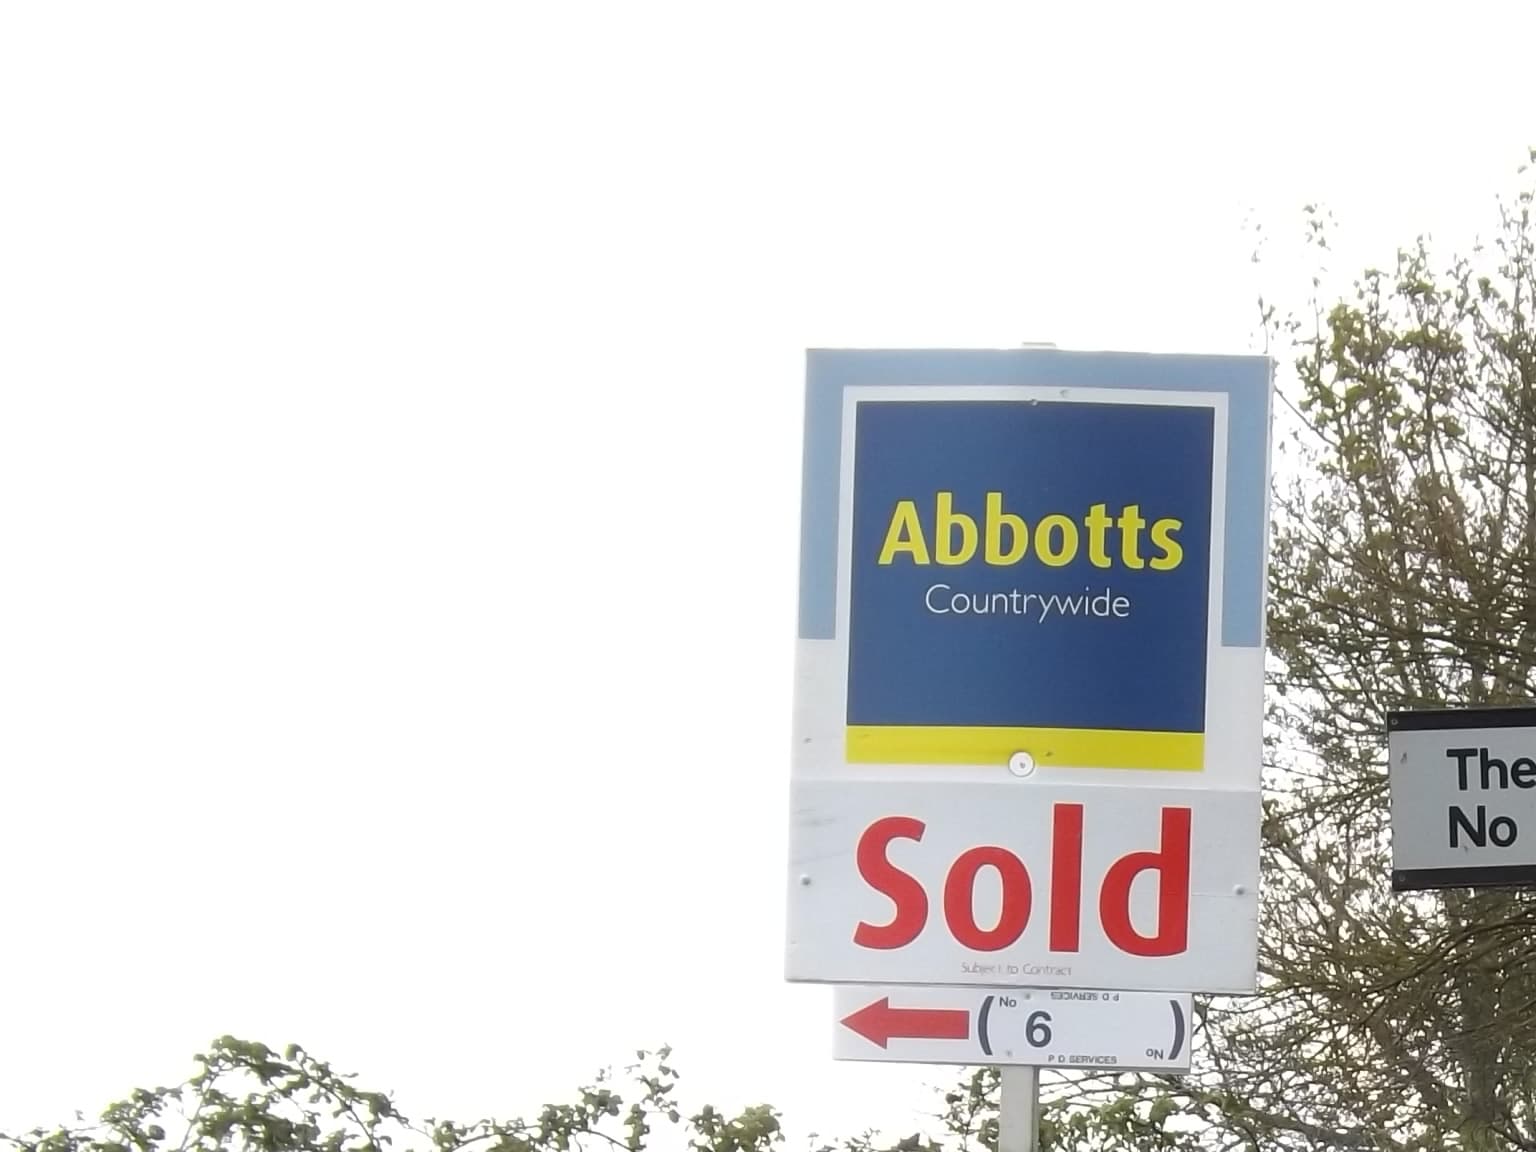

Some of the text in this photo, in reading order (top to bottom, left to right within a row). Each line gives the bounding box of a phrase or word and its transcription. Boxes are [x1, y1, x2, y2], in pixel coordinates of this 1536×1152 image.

[878, 490, 1184, 571] Abbotts
[925, 584, 1131, 624] Countrywide
[1448, 804, 1519, 849] No
[853, 802, 1193, 958] Sold
[961, 961, 1072, 976] Subject to Contract
[999, 996, 1017, 1008] No
[1051, 992, 1098, 1001] SERVICES
[1025, 1010, 1052, 1048] 6
[1048, 1055, 1055, 1063] P
[1069, 1055, 1117, 1065] SERVICES
[1145, 1048, 1164, 1060] No
